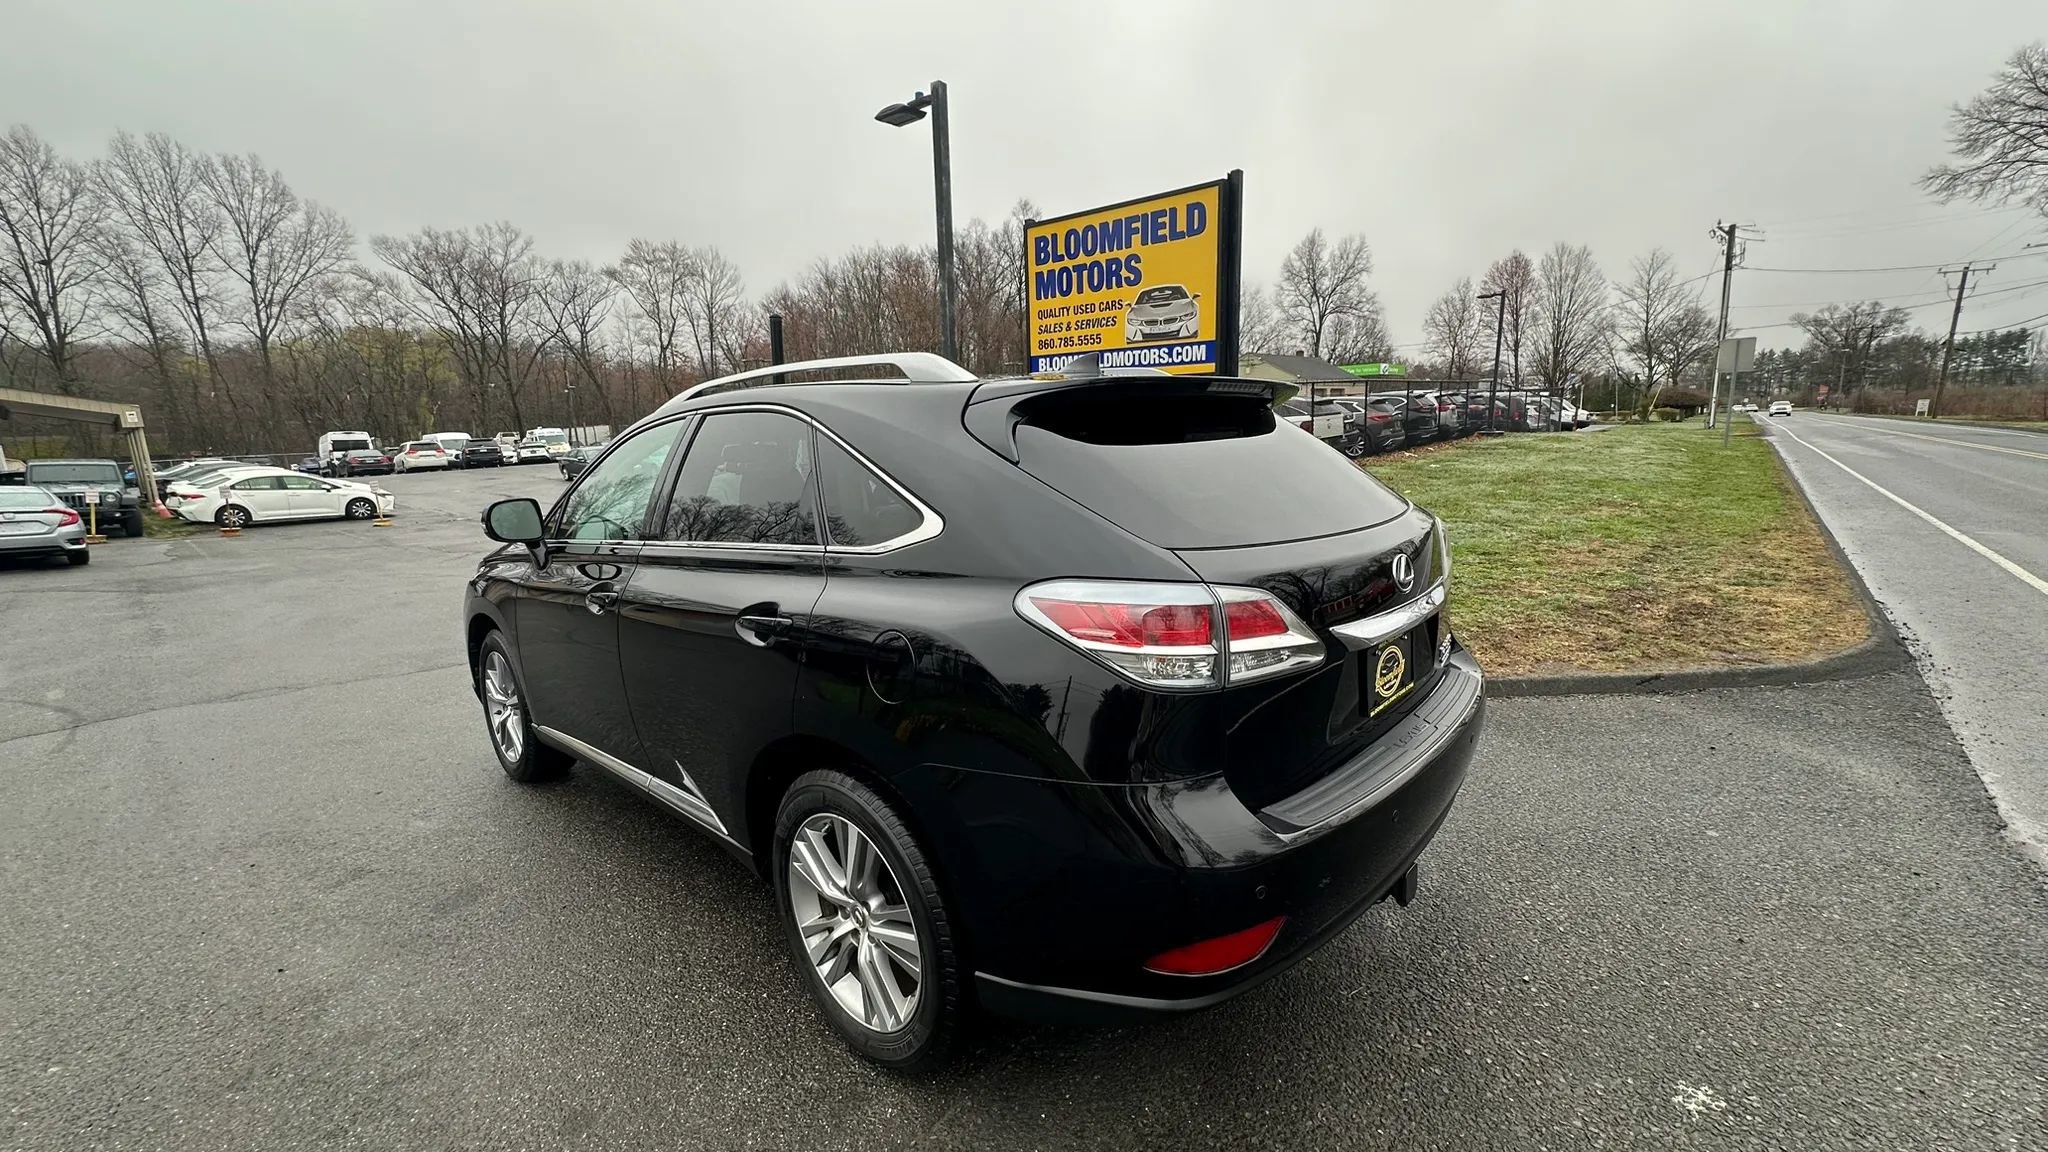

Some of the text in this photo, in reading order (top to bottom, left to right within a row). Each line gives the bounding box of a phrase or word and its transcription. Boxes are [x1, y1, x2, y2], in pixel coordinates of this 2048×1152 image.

[1034, 202, 1207, 266] BLOOMFIELD
[1035, 253, 1142, 300] MOTORS
[1037, 299, 1123, 320] QUALITY USED CARS
[1037, 316, 1117, 335] SALES & SERVICES
[1038, 333, 1102, 350] 860.785.5555
[1038, 345, 1206, 372] BLOODMOTORS.COM
